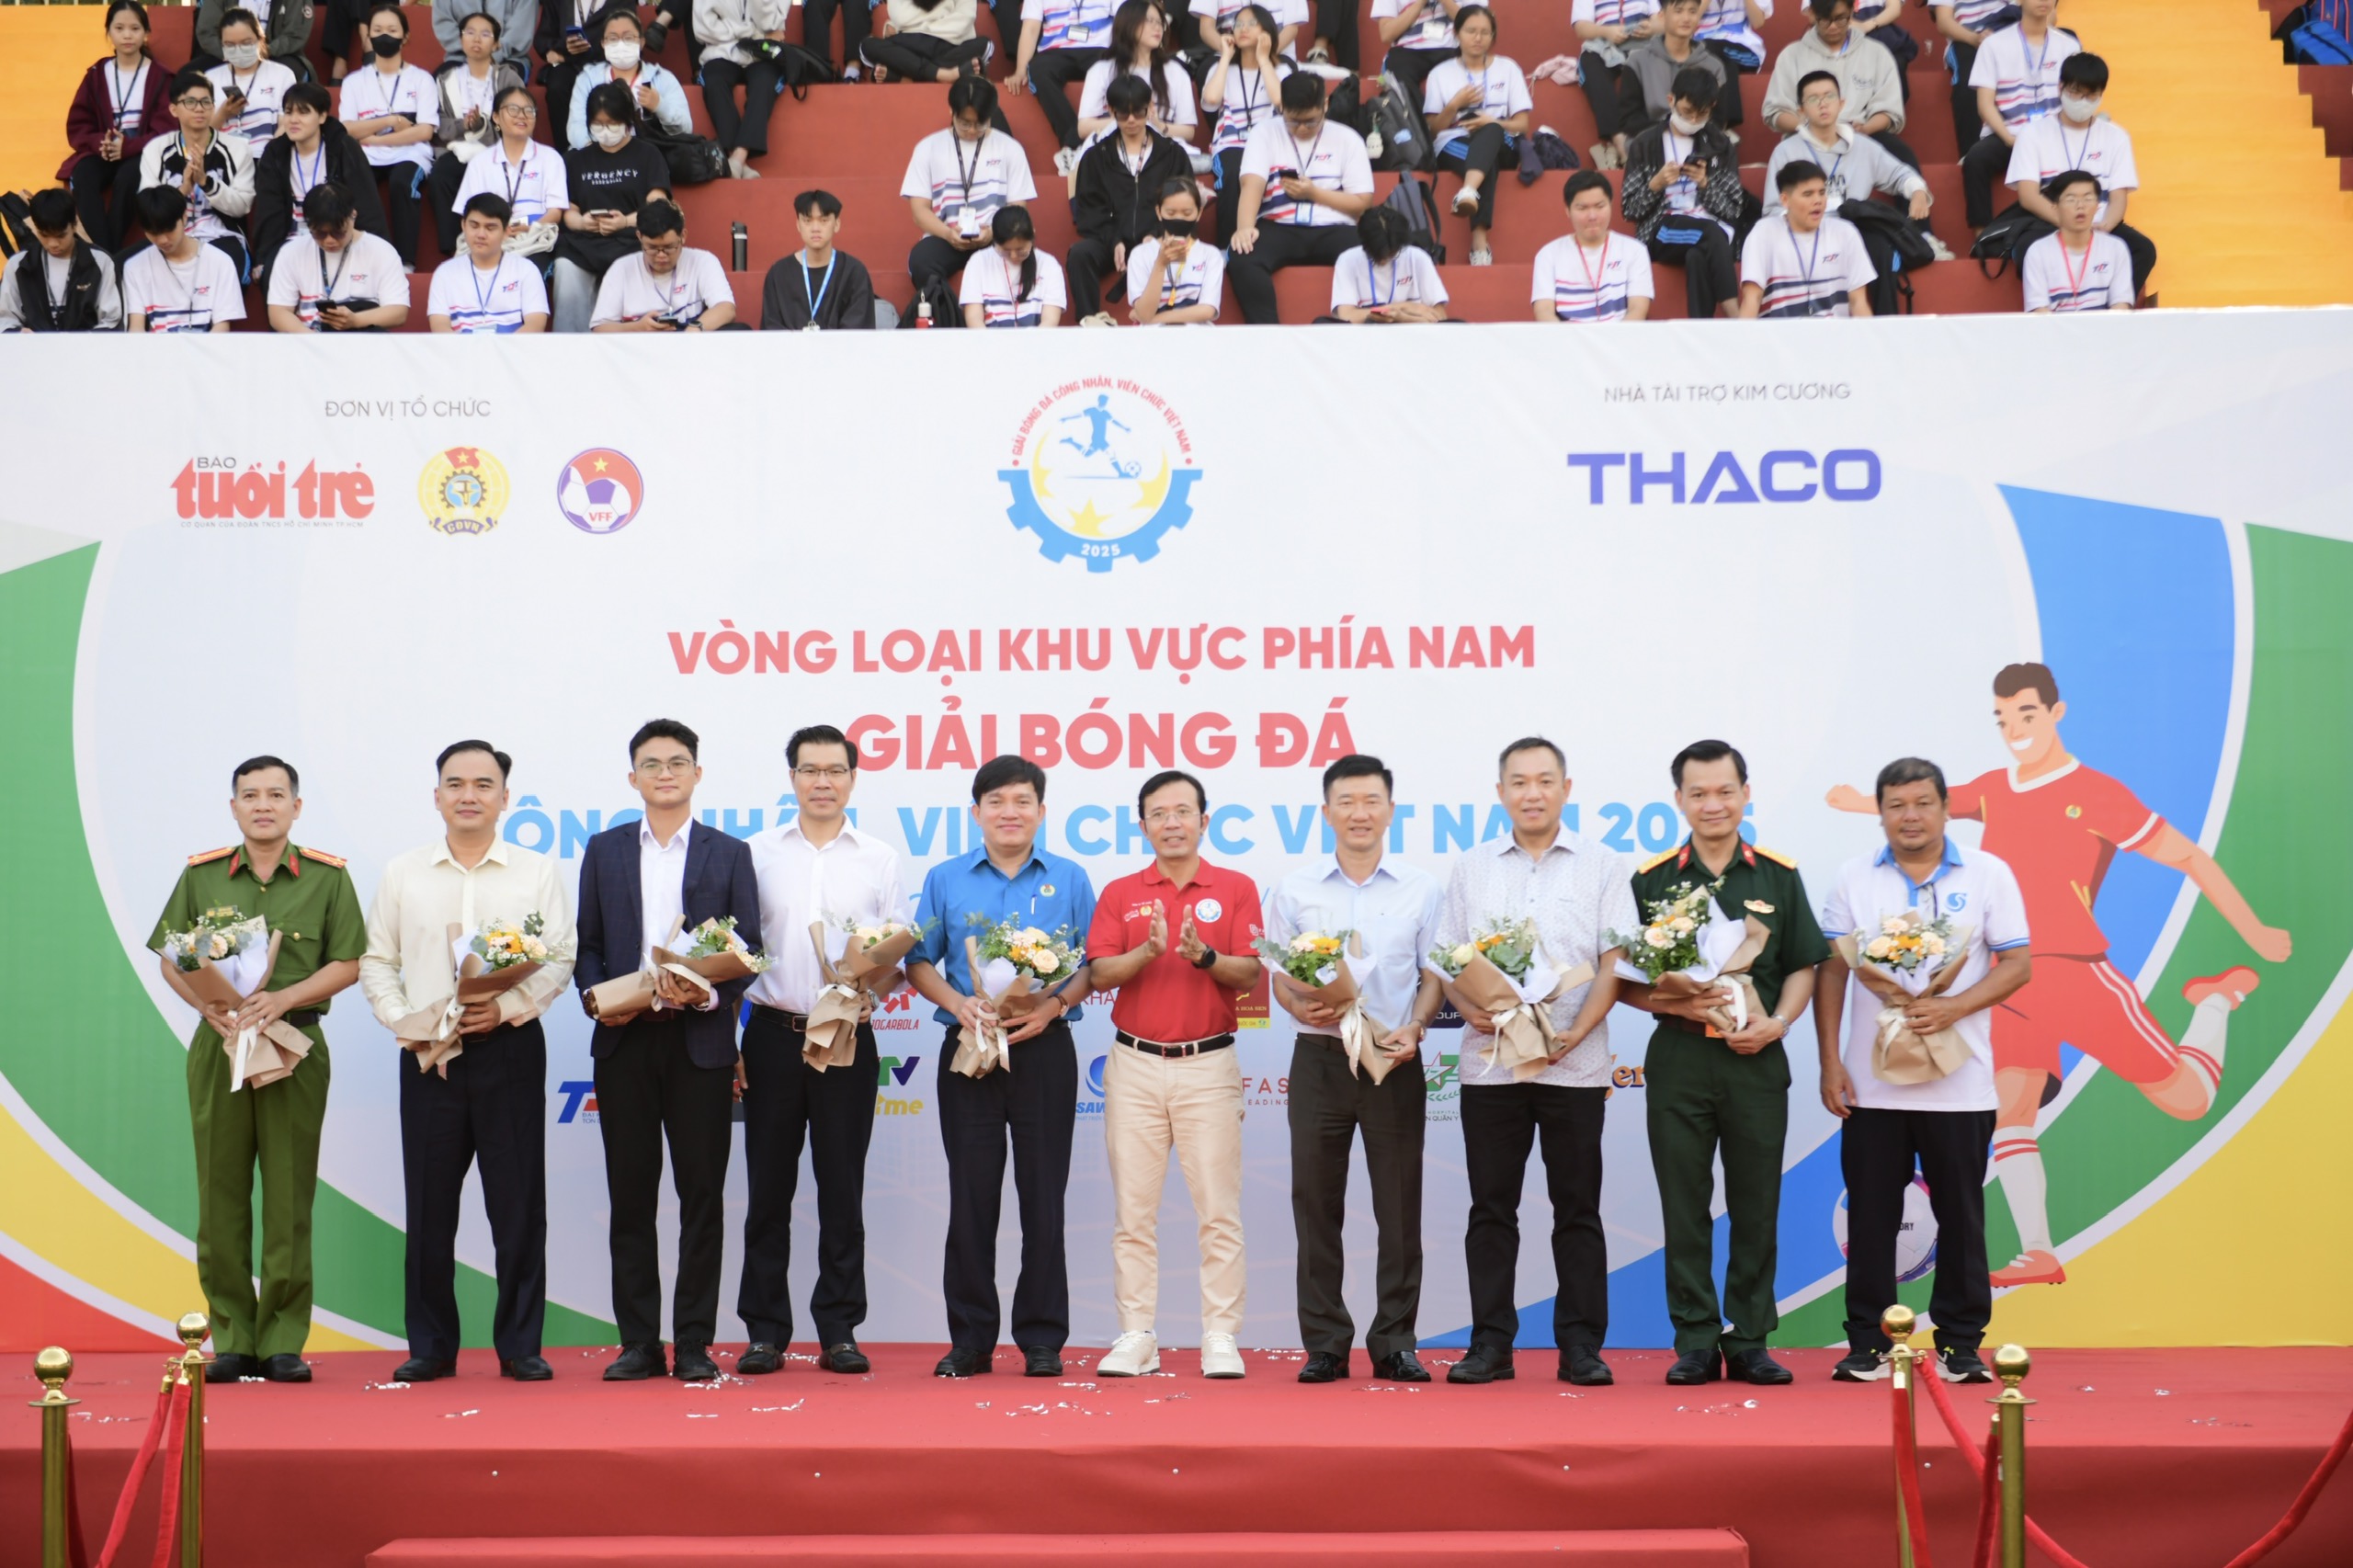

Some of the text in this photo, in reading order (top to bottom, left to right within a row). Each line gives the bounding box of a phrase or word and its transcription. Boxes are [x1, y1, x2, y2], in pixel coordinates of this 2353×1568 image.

[324, 393, 492, 421] ĐƠN VỊ TỔ CHỨC
[1052, 381, 1080, 400] CÔNG
[1118, 379, 1141, 394] VIÊN
[1176, 428, 1192, 454] NAM
[1604, 381, 1852, 405] NHÀ TÀI TRỢ KIM CƯƠNG
[1567, 449, 1881, 505] THACO
[588, 511, 613, 522] VFF
[1081, 543, 1120, 557] 2025
[667, 615, 1535, 687] VÒNG LOẠI KHU VỰC PHÍA NAM
[845, 695, 1358, 771] GIẢI BÓNG ĐÁ
[1064, 800, 1255, 856] CHC
[1271, 804, 1415, 854] VIT
